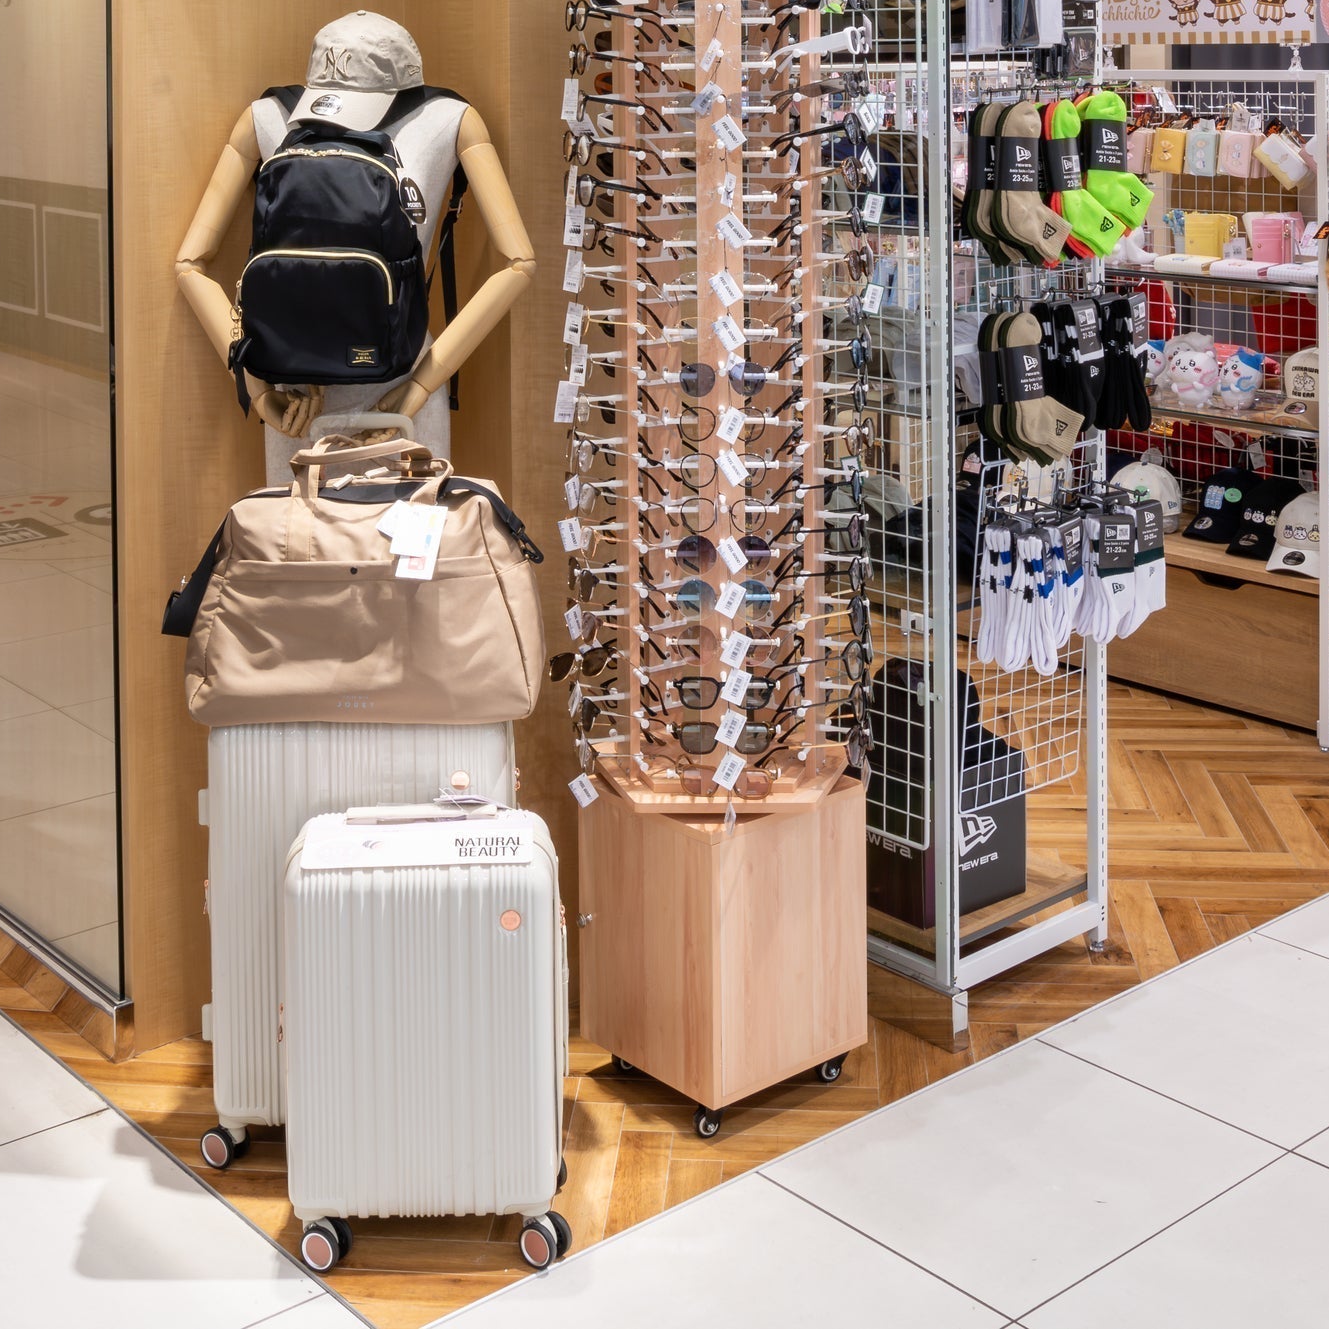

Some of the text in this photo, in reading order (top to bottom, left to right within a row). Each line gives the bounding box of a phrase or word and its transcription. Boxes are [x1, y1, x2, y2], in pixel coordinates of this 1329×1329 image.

[404, 186, 418, 201] 10
[455, 836, 524, 847] NATURAL
[459, 846, 519, 858] BEAUTY
